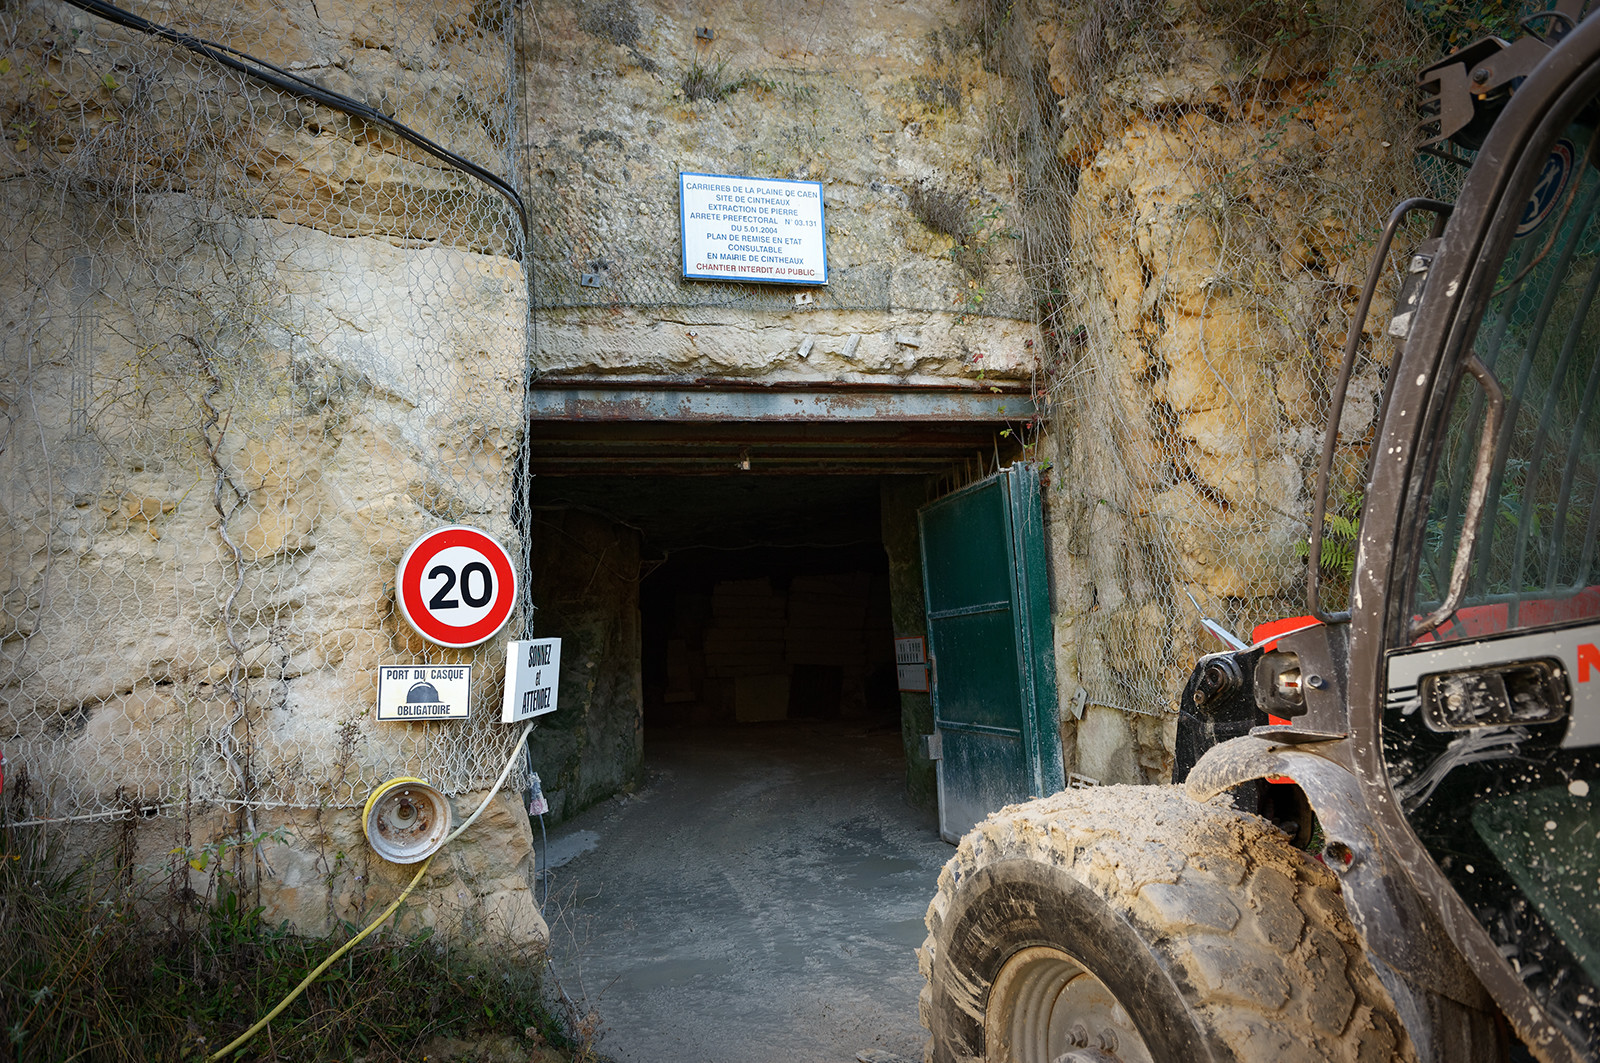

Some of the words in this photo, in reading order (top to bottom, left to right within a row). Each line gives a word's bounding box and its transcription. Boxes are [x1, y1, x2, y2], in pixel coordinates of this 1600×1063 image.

[686, 183, 731, 192] CARRIERES
[757, 188, 783, 196] PLAINE
[797, 190, 818, 198] CAEN
[747, 197, 790, 206] CINTHEAUX
[708, 204, 757, 213] EXTRACTION
[771, 208, 798, 216] PIERRE
[723, 215, 778, 224] PREFECTORAL
[744, 225, 777, 233] 5.01.2004
[741, 235, 770, 243] REMISE
[728, 244, 782, 253] CONSULTABLE
[761, 256, 804, 264] CINTHEAUX
[696, 263, 736, 271] CHANTIER
[738, 265, 773, 273] INTERDIT
[428, 562, 493, 610] 20
[528, 644, 552, 668] SONNEZ
[386, 670, 409, 680] PORT
[414, 670, 427, 679] DU
[431, 669, 464, 680] CASQUE
[535, 670, 541, 686] et
[521, 687, 551, 714] ATTENDEZ
[397, 705, 450, 715] OBLIGATOIRE
